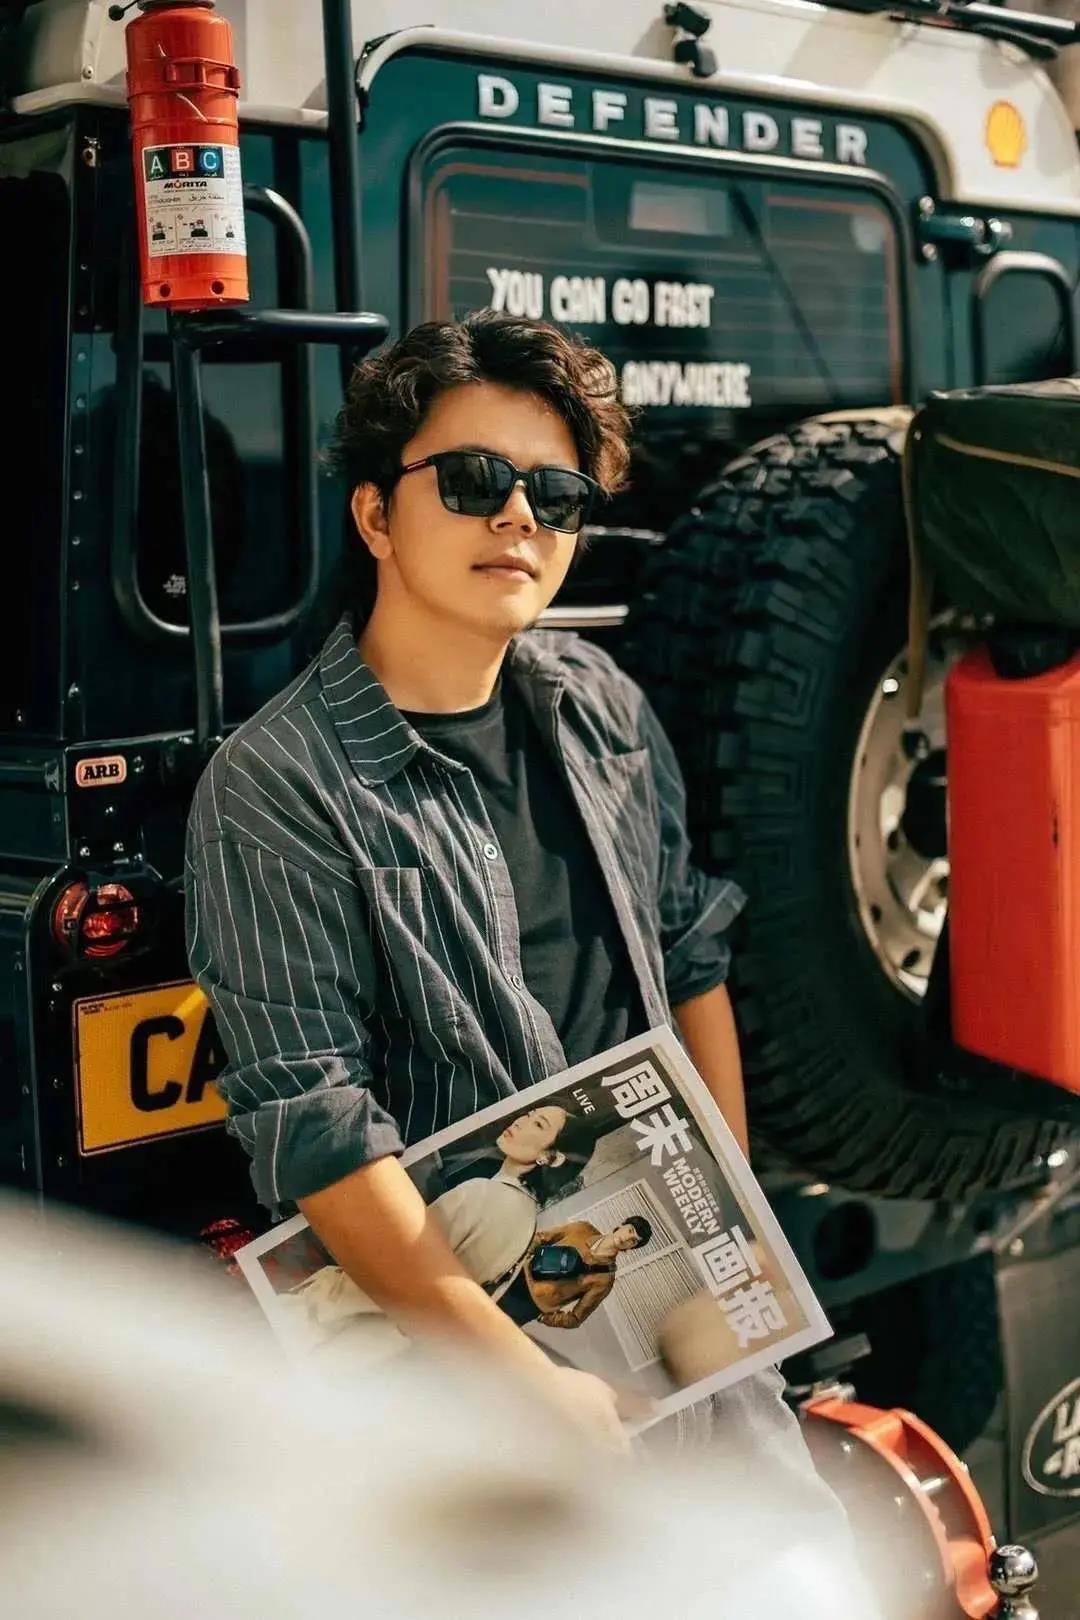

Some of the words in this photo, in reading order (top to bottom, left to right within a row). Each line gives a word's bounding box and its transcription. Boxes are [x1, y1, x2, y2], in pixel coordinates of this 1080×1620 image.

[476, 73, 868, 165] DEFENDER
[151, 155, 164, 173] A
[175, 152, 190, 170] B
[203, 151, 217, 169] C
[164, 180, 208, 189] MORITA
[486, 267, 543, 320] YOU
[551, 275, 606, 324] CAN
[612, 278, 649, 325] GO
[654, 281, 714, 328] FAST
[621, 361, 751, 407] ANYWHERE
[83, 763, 120, 780] ARB
[130, 1006, 229, 1113] CA
[572, 1088, 596, 1115] LIVE
[601, 1060, 694, 1167] 周末
[663, 1167, 705, 1235] WEEKLY
[672, 1156, 721, 1235] MODERN
